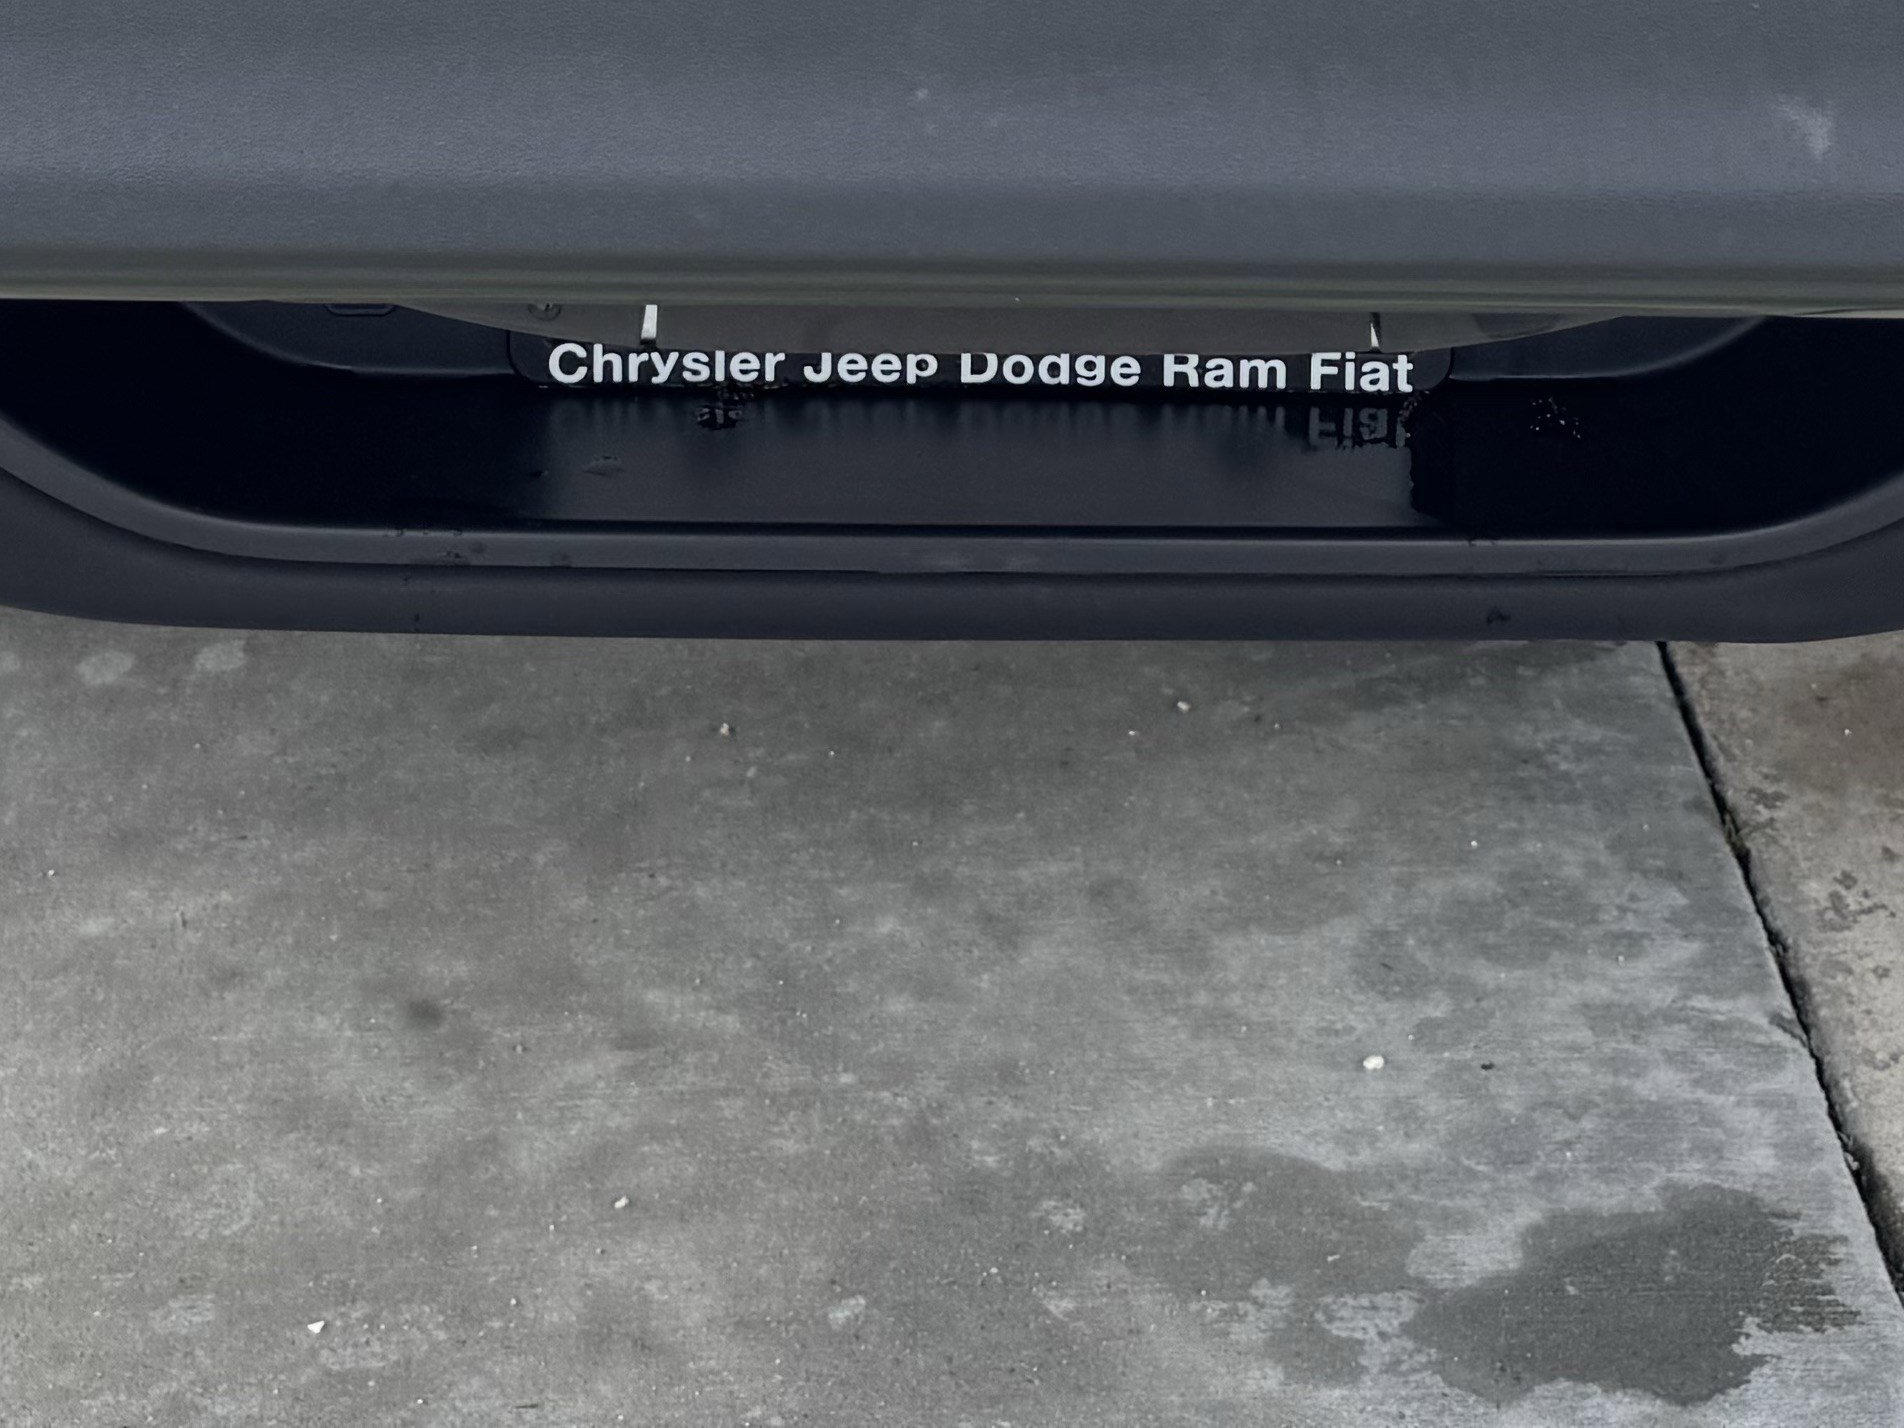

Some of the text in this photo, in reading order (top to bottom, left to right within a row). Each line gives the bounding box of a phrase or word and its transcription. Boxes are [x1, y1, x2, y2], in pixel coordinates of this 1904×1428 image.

[548, 342, 1414, 393] Chrysler Jeep Dodge Ram Fiat
